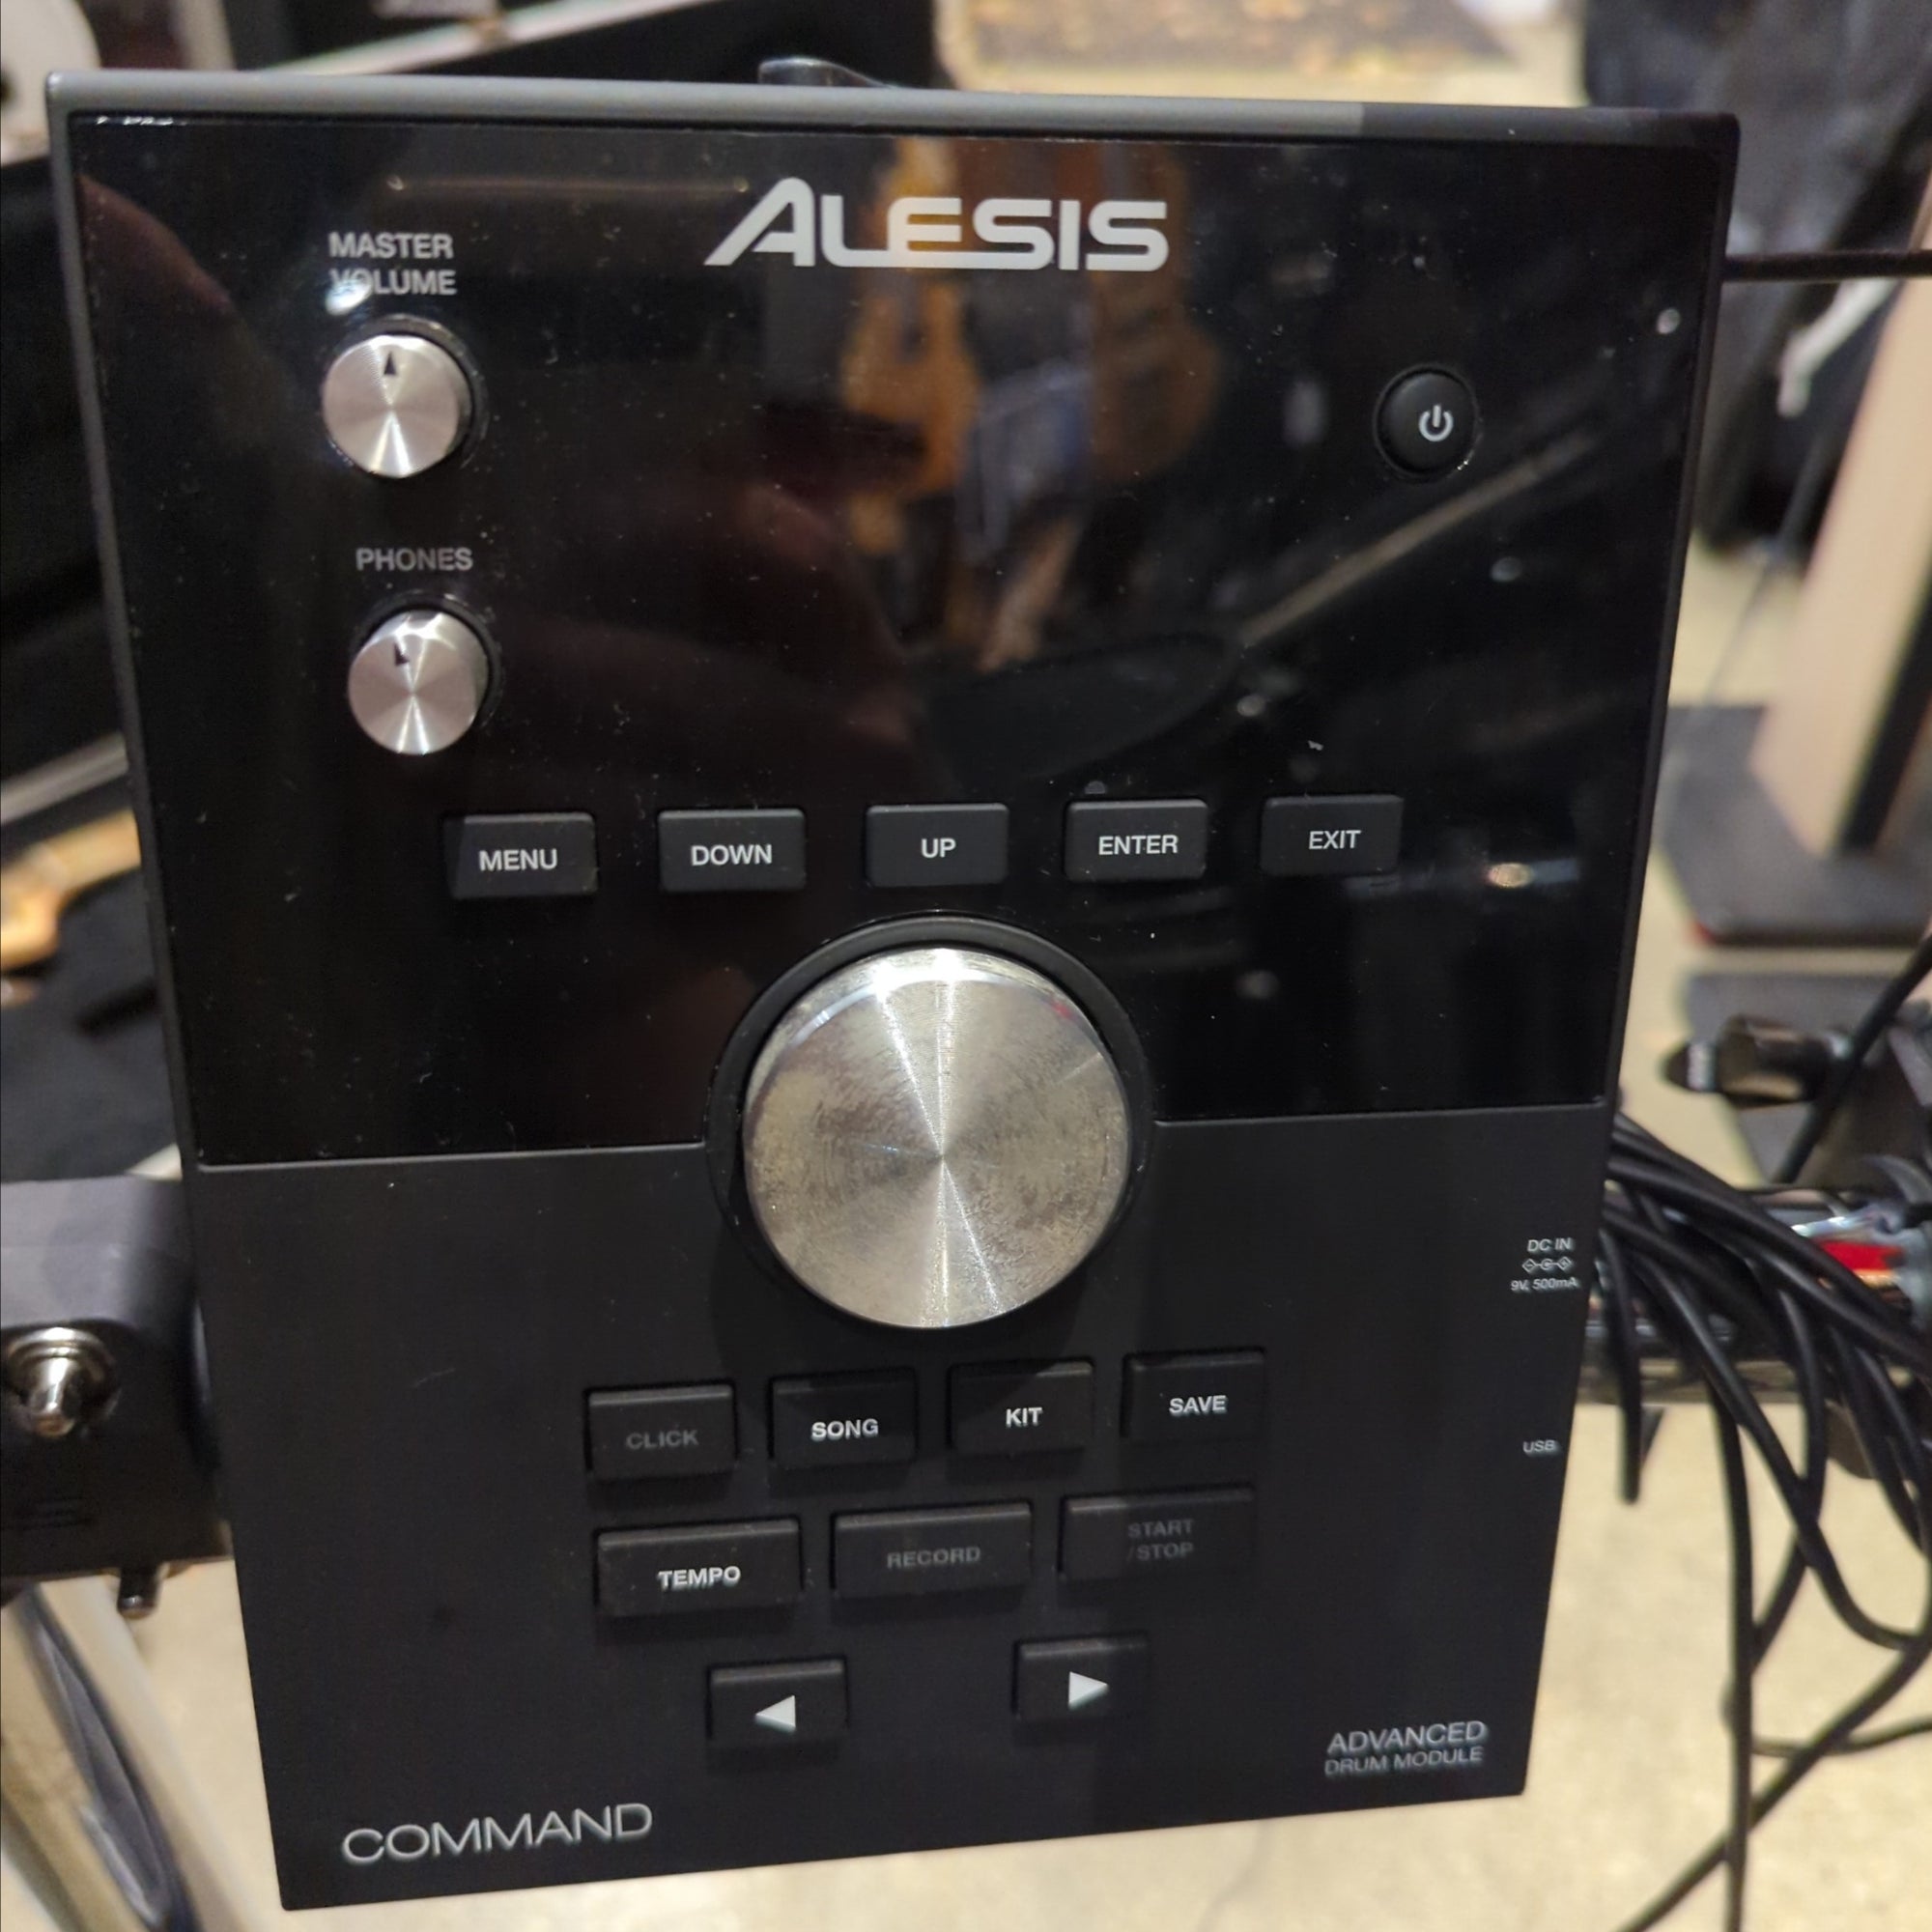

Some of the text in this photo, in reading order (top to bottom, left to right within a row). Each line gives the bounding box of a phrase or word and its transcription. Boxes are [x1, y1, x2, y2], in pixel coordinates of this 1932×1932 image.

[704, 177, 1170, 272] ALESIS
[327, 232, 455, 260] MASTER
[328, 268, 457, 297] VOLUME
[355, 547, 474, 572] PHONES
[921, 837, 957, 860] UP
[1096, 834, 1180, 858] ENTER
[1308, 829, 1362, 851] EXIT
[478, 847, 559, 873] MENU
[689, 842, 774, 867] DOWN
[1527, 1237, 1575, 1253] DC IN
[1532, 1276, 1579, 1291] 500mA
[1169, 1394, 1228, 1416] SAVE
[1005, 1406, 1043, 1429] KIT
[625, 1428, 699, 1449] CLICK
[810, 1418, 880, 1441] SONG
[1522, 1438, 1558, 1457] USB
[1127, 1519, 1194, 1540] START
[886, 1546, 982, 1569] RECORD
[1126, 1541, 1195, 1563] /STOP
[657, 1564, 743, 1590] TEMPO
[1327, 1719, 1489, 1755] ADVANCED
[1324, 1745, 1485, 1777] DRUM MODULE
[341, 1801, 654, 1866] COMMAND
